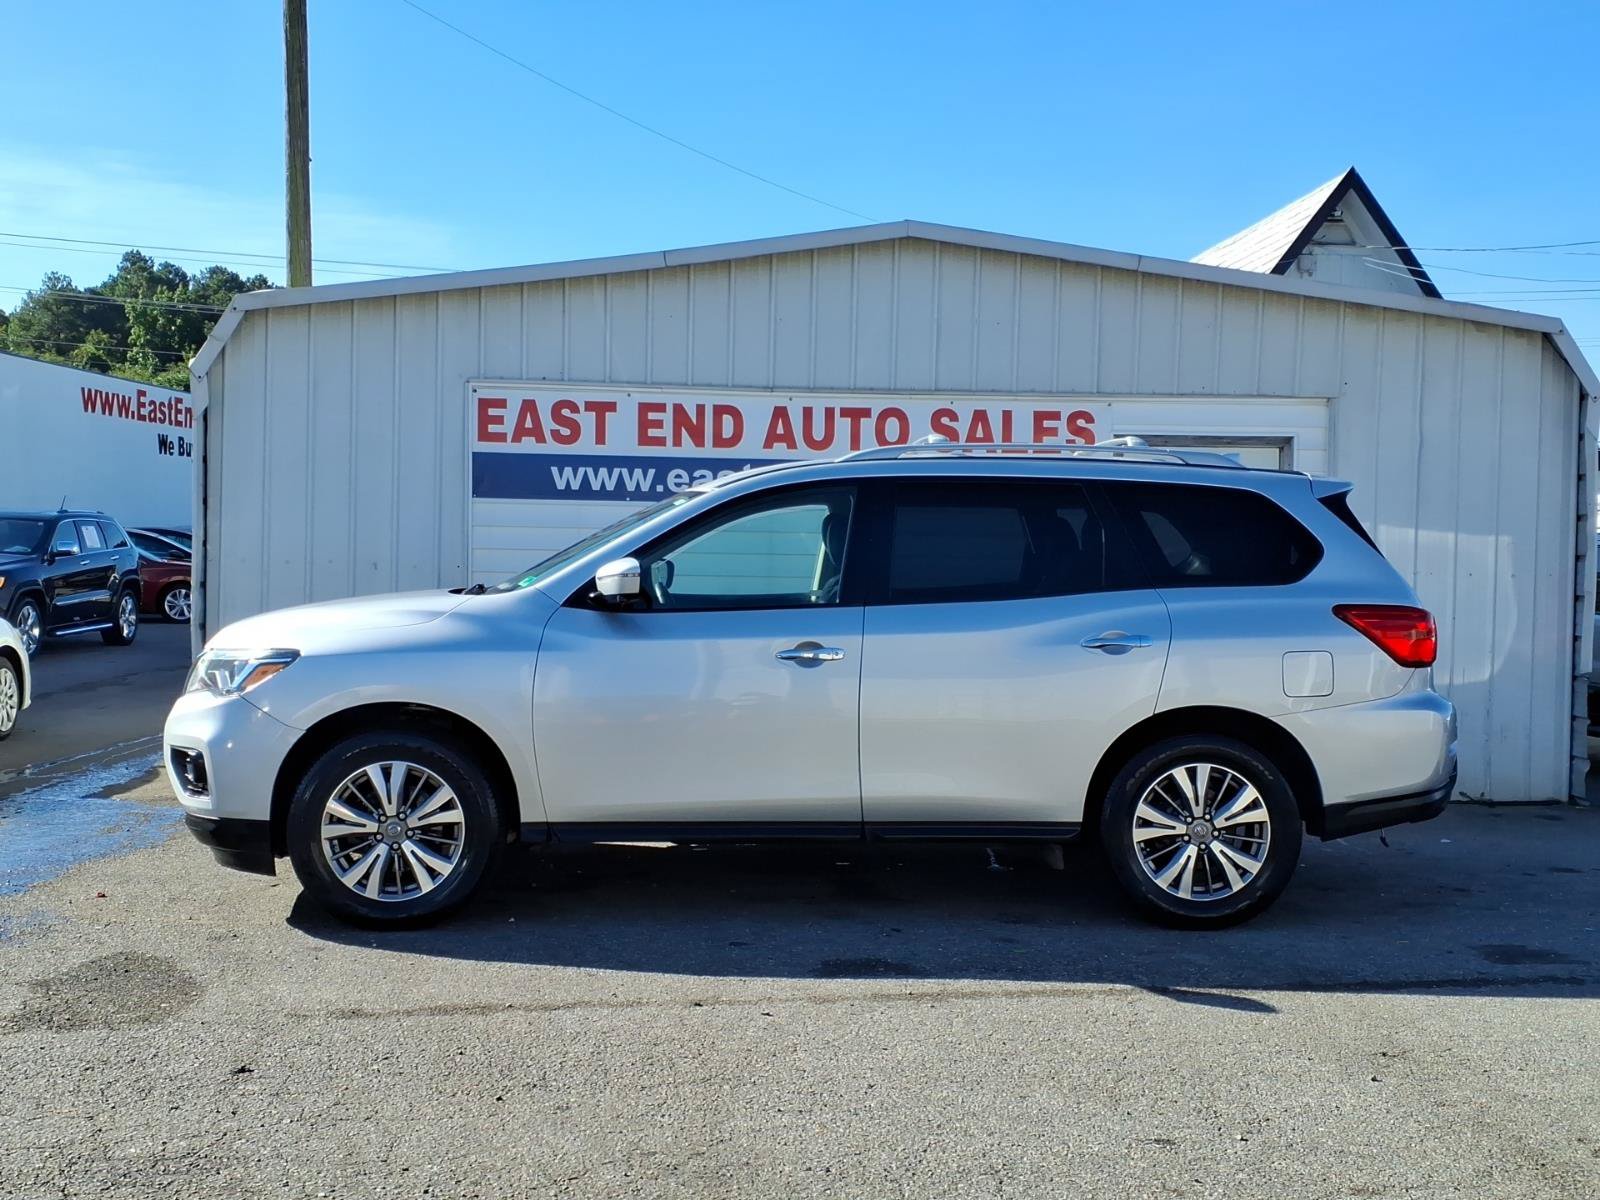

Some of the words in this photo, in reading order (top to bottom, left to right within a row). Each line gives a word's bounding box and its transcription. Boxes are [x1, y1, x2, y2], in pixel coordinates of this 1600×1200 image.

[477, 397, 618, 447] EAST
[637, 402, 744, 449] END
[763, 406, 911, 451] AUTO
[930, 407, 1096, 454] SALES
[157, 433, 175, 456] We
[178, 435, 193, 460] Bu
[550, 464, 751, 493] www.ea
